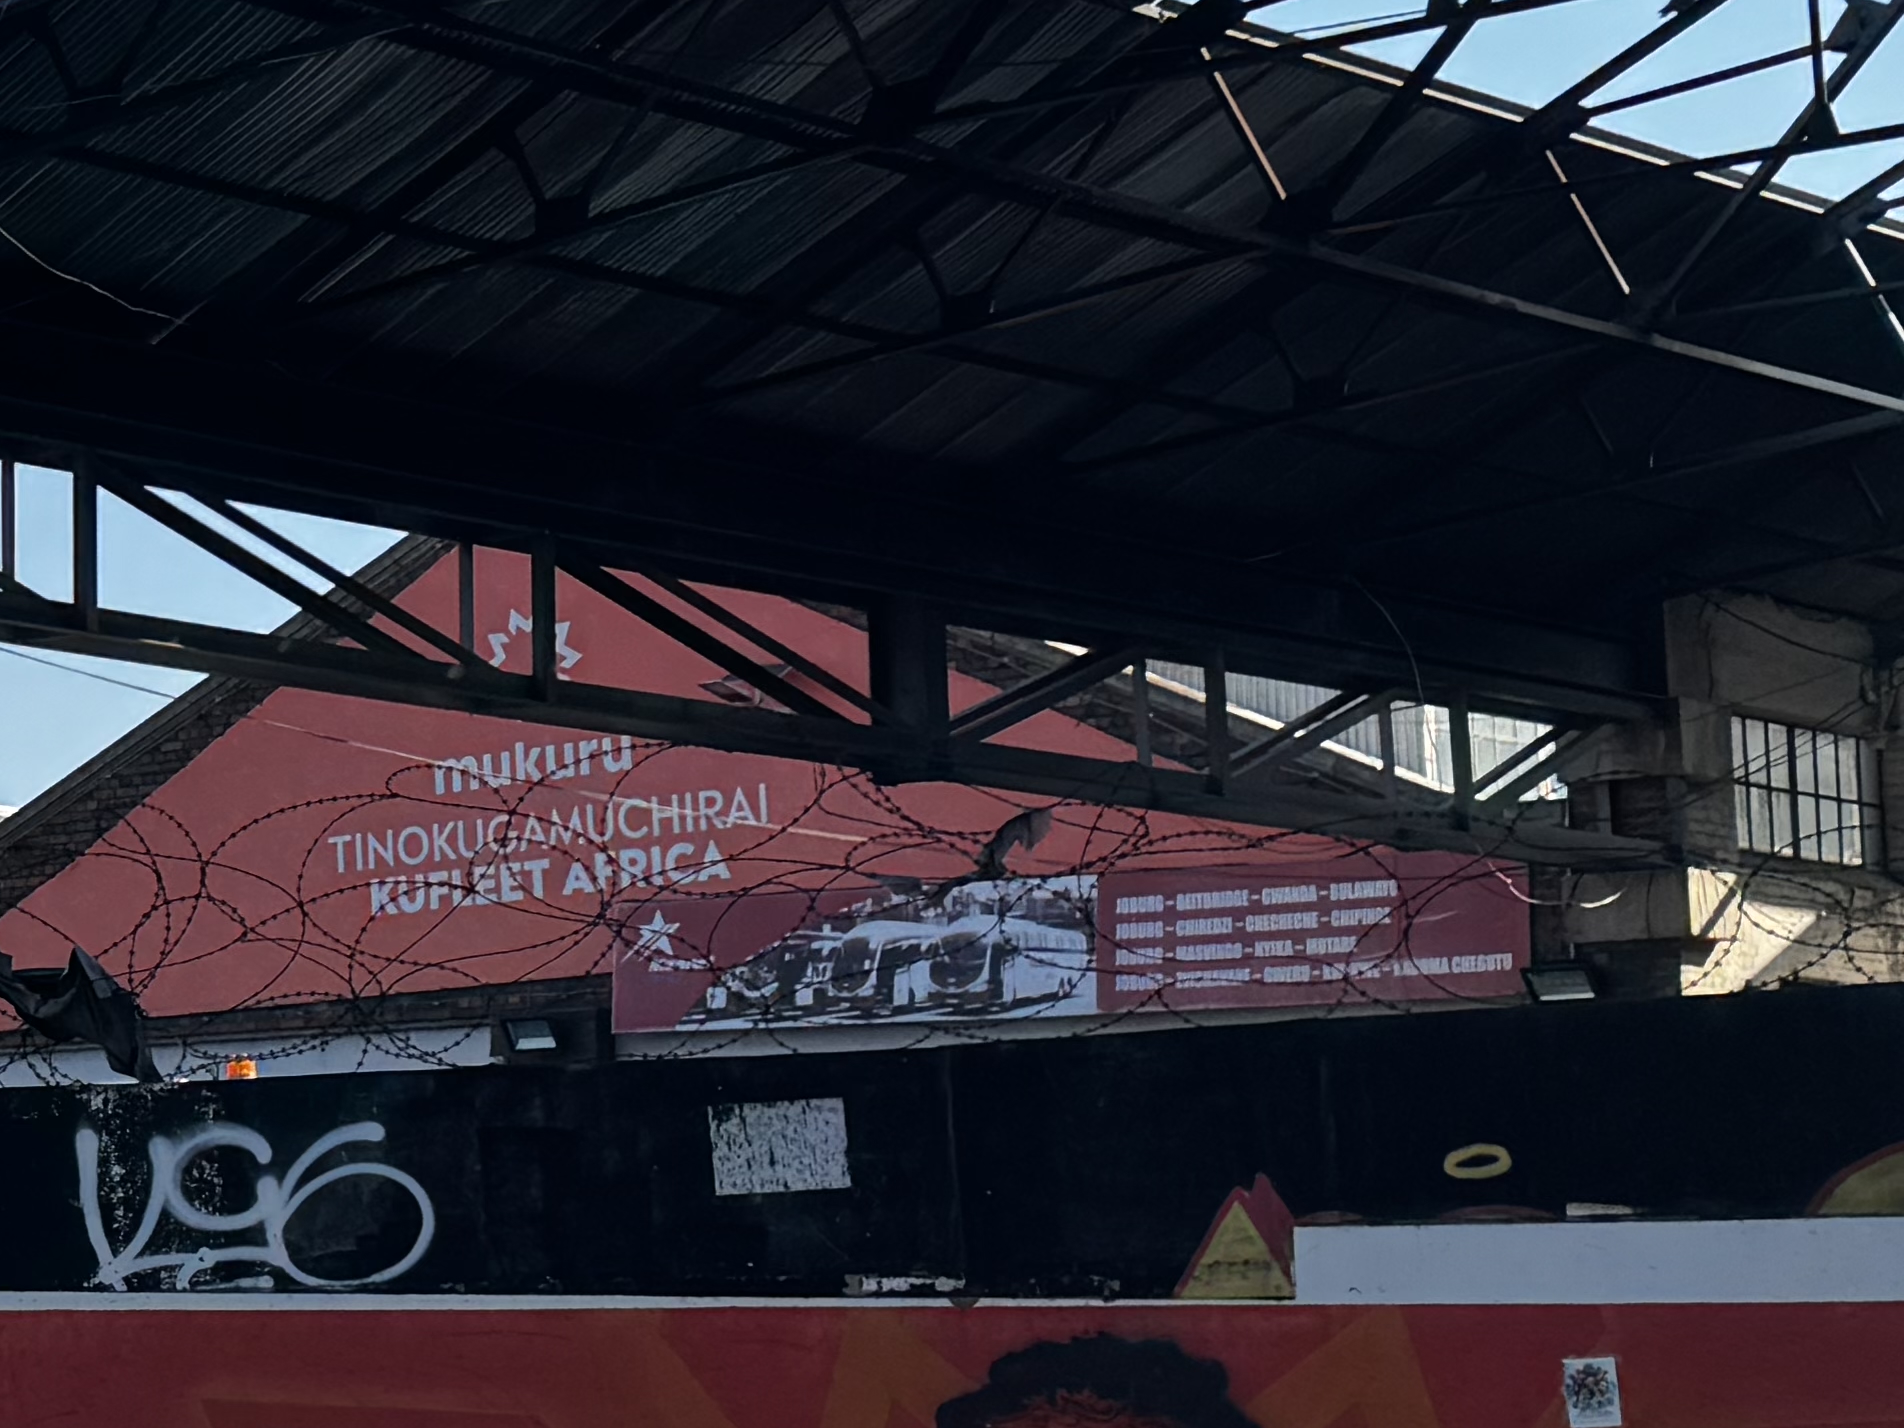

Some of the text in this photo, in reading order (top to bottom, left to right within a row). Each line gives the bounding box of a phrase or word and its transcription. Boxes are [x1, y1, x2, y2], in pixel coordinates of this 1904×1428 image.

[433, 735, 633, 795] mukuru
[328, 783, 767, 873] TINOKUGAMUCHIRAI
[369, 840, 731, 917] KUFLEET AFRICA
